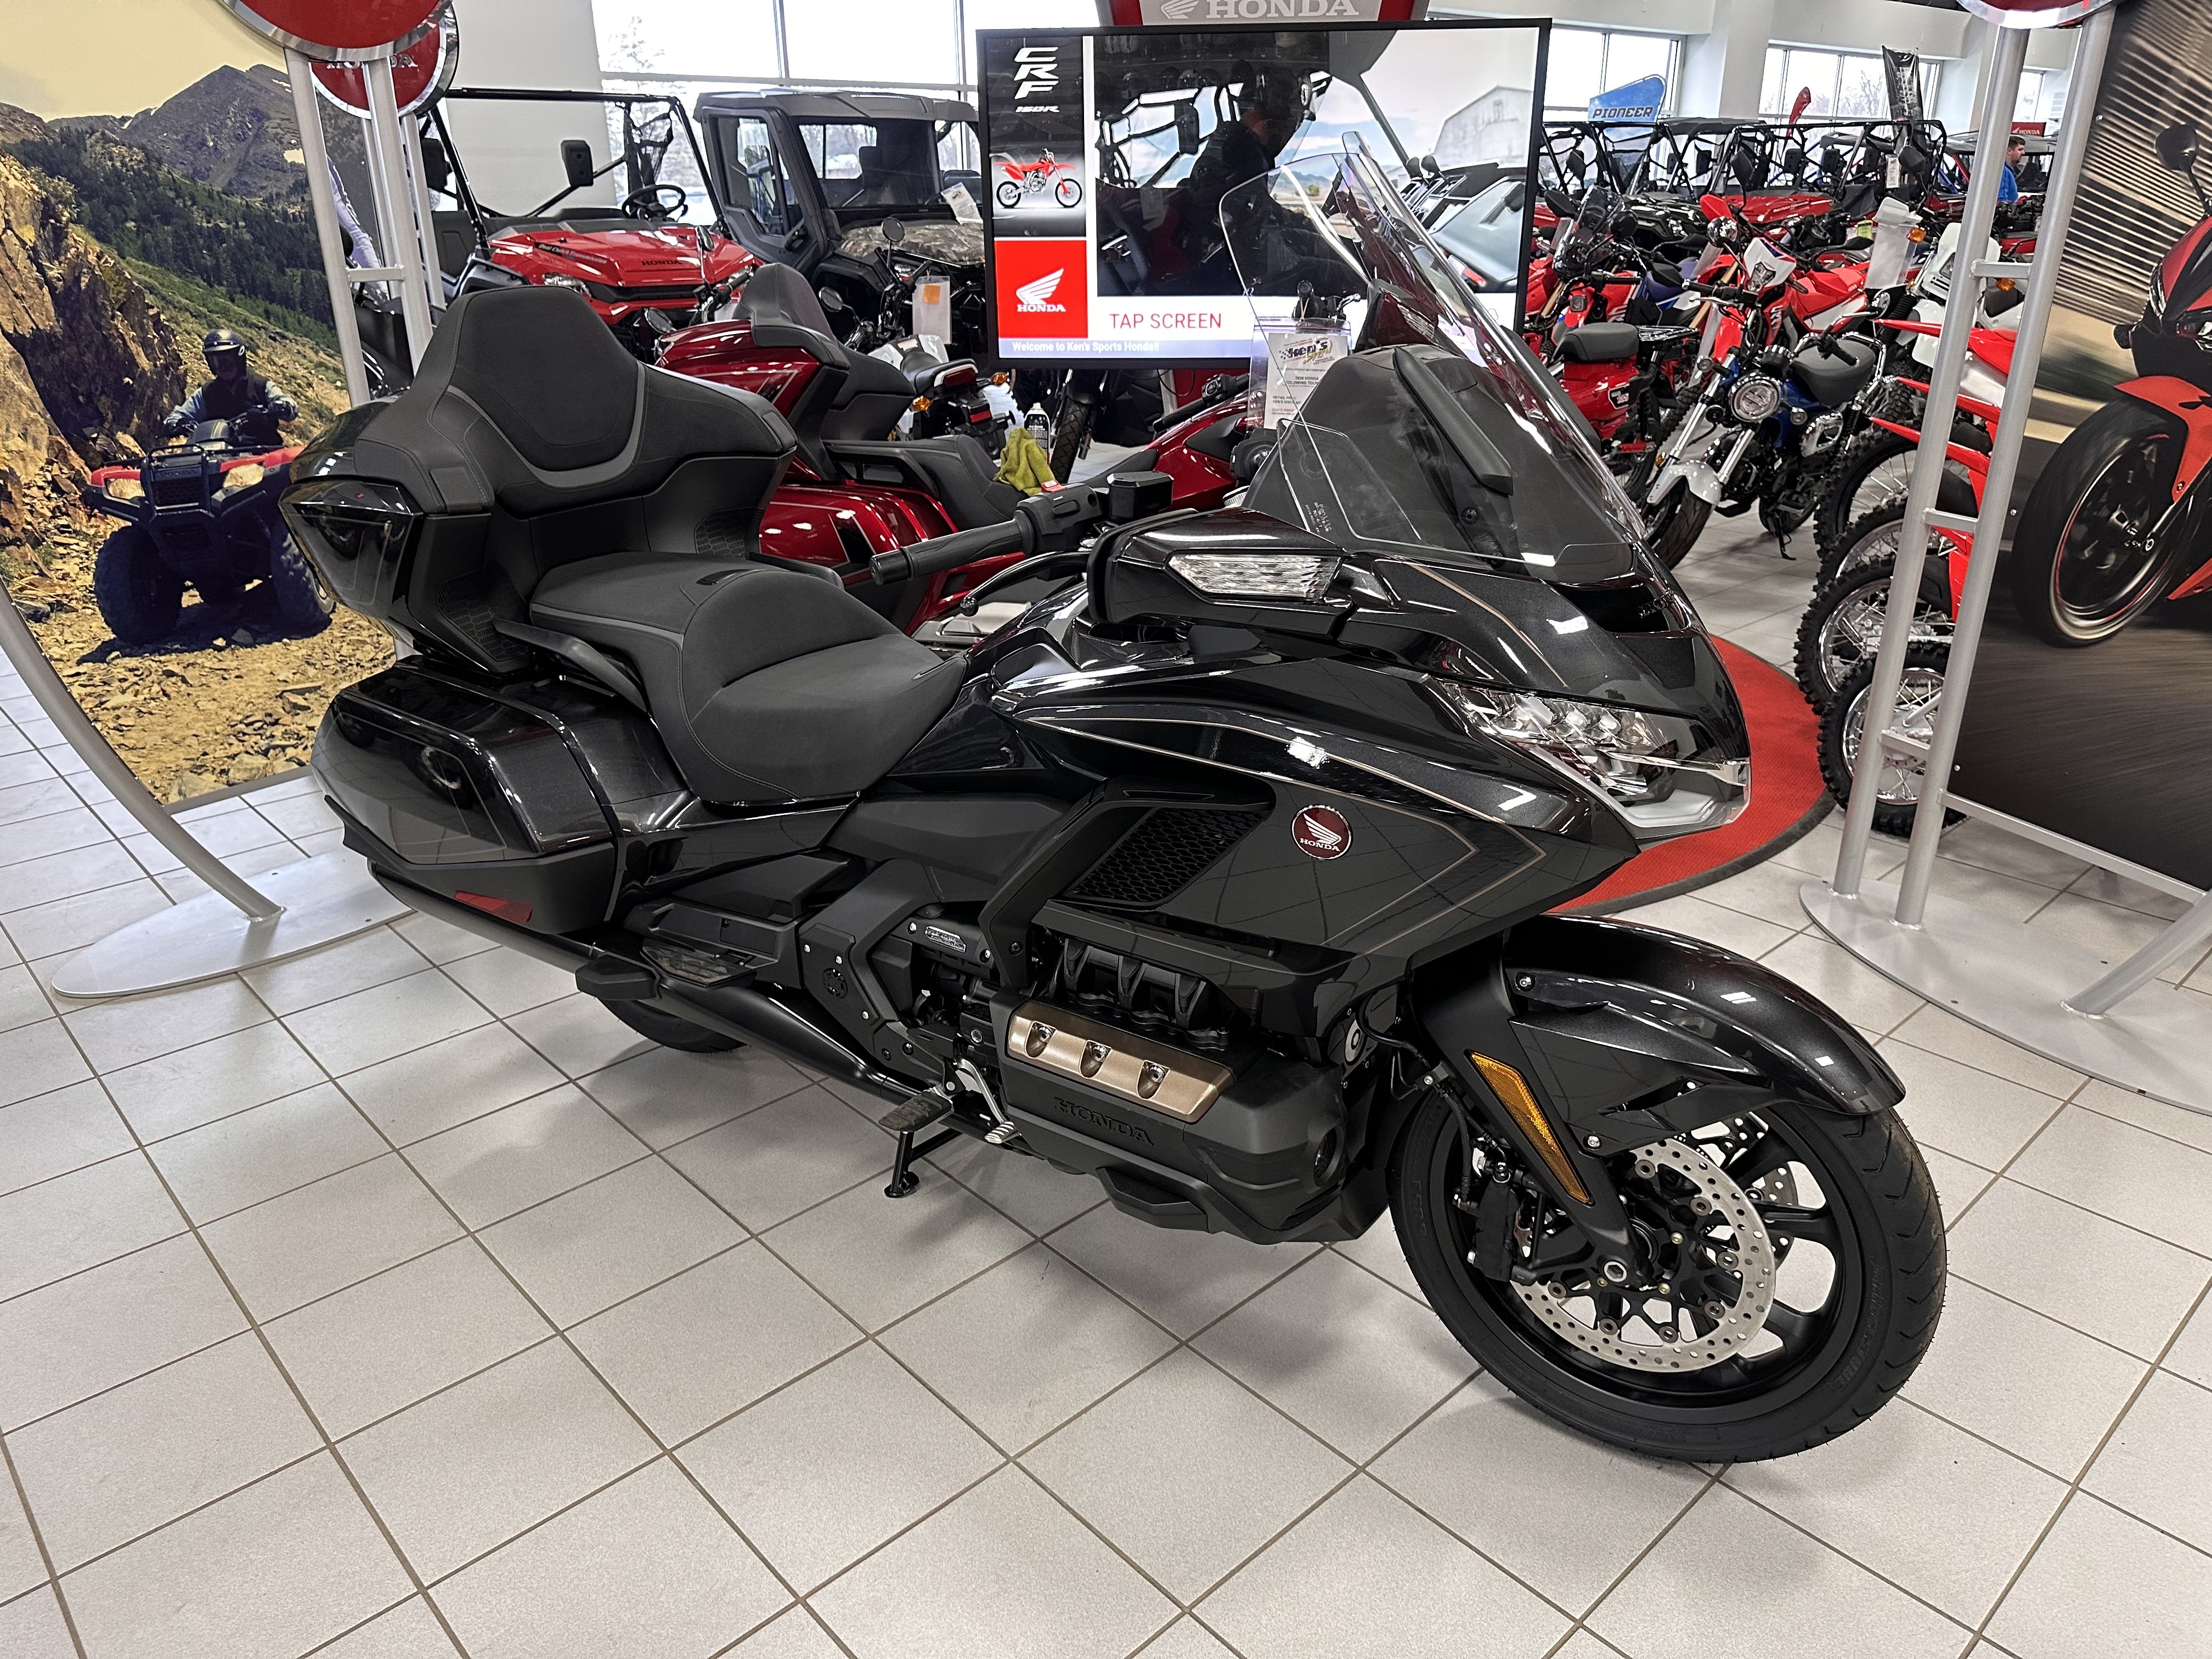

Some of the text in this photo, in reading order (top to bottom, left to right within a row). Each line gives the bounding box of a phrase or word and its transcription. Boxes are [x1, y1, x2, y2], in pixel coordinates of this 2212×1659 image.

[1206, 0, 1359, 18] HONDA
[1592, 107, 1654, 119] PIONEER
[1017, 304, 1066, 312] HONDA
[1109, 313, 1222, 329] TAP SCREEN
[1012, 342, 1054, 352] Welcome
[1056, 342, 1065, 352] to
[1067, 342, 1090, 352] Ken's
[1092, 341, 1122, 353] Sports
[1300, 838, 1340, 851] HONDA
[1054, 1097, 1154, 1146] HONDA
